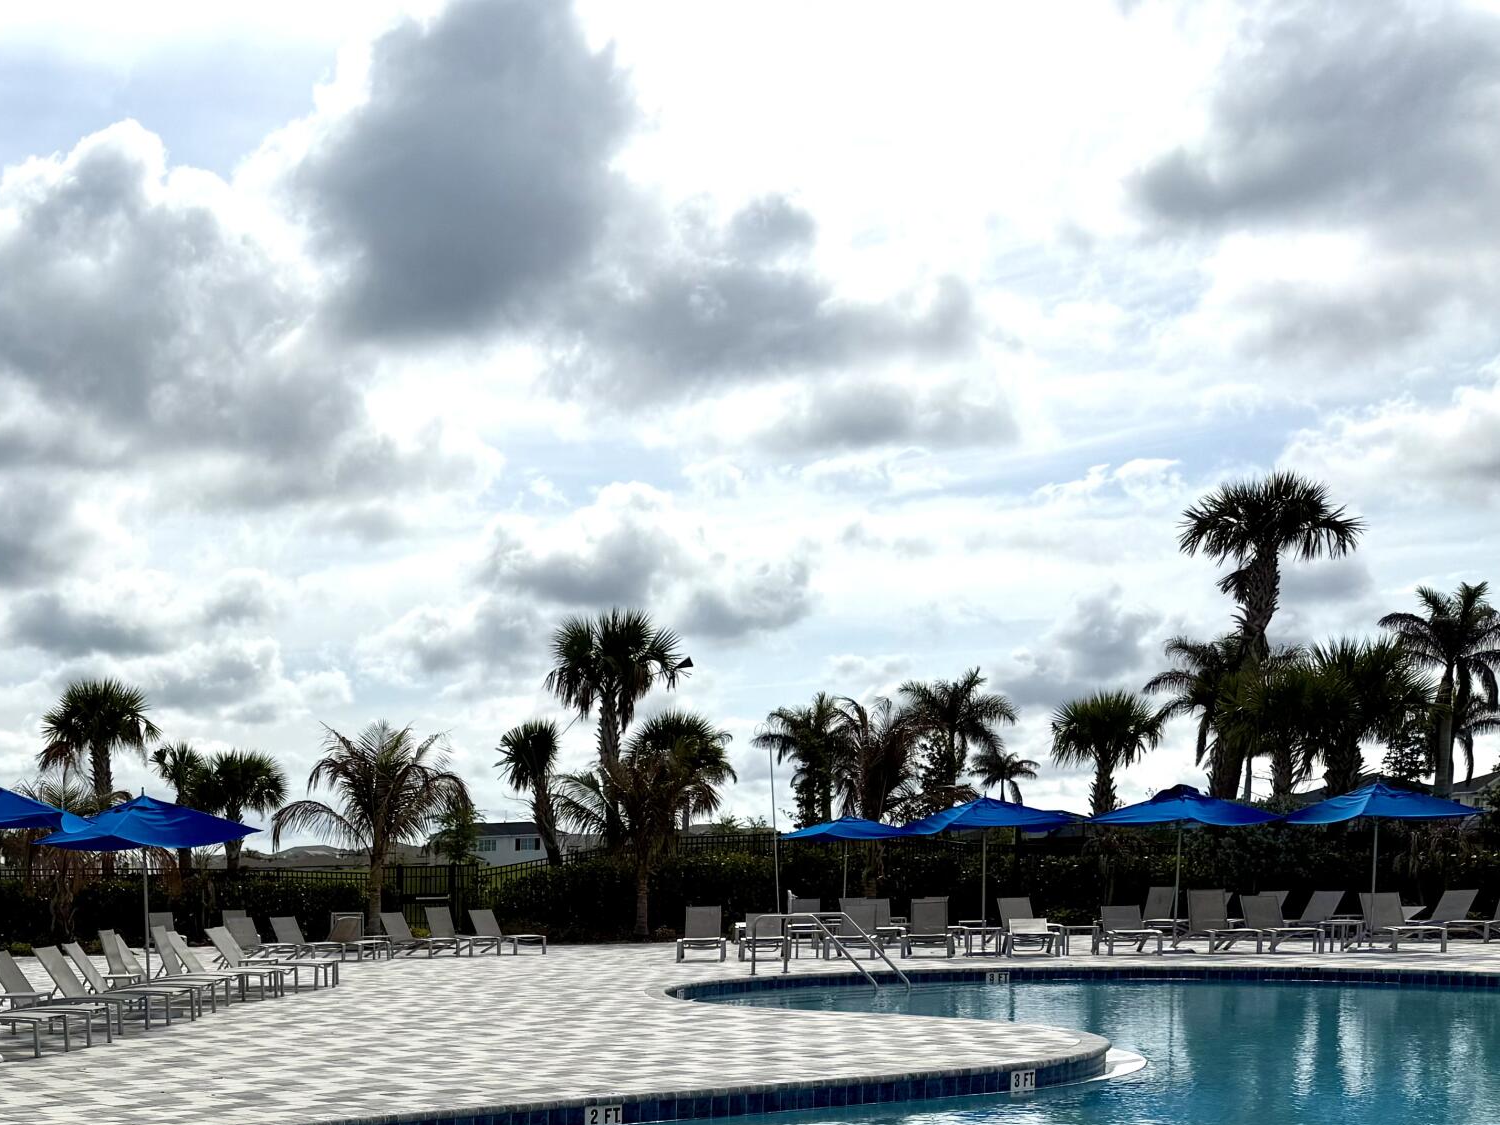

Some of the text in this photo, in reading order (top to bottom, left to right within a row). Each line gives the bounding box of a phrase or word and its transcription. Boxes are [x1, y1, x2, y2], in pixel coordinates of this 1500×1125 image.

[1014, 1073, 1020, 1088] 3
[590, 1107, 621, 1125] 2 FT.
